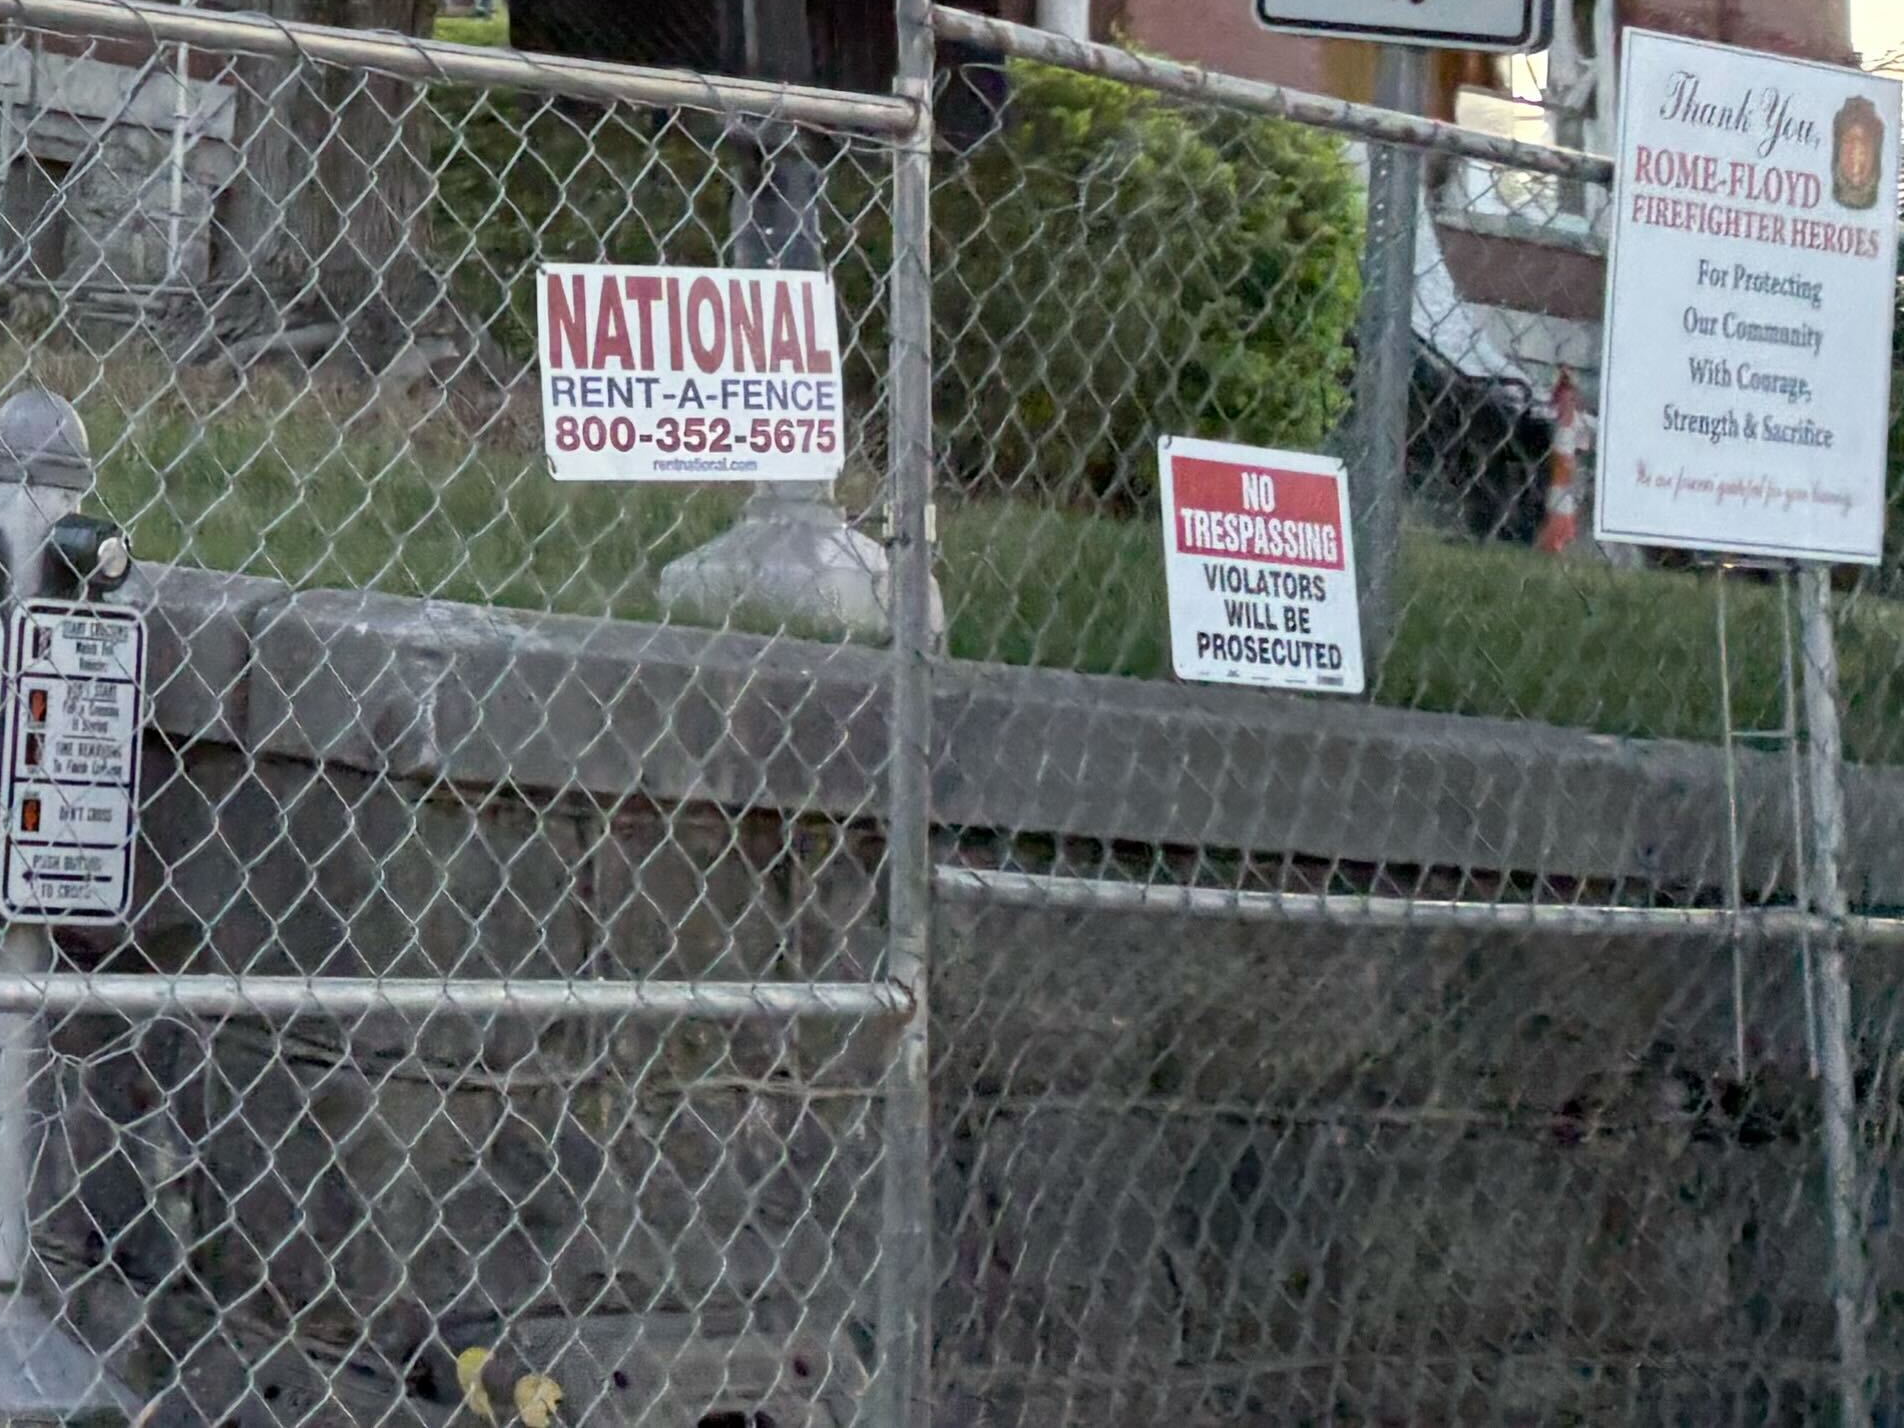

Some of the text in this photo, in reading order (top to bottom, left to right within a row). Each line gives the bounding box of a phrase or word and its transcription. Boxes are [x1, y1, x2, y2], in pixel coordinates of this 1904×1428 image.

[1660, 71, 1821, 158] Thank You,
[1635, 145, 1821, 210] ROME-FLOYD
[1631, 194, 1881, 259] FIREFIGHTER HEROES
[1697, 259, 1823, 310] For Protecting
[547, 274, 833, 375] NATIONAL
[1683, 306, 1824, 357] Our Community
[550, 375, 837, 412] RENT-A-FENCE
[1688, 357, 1812, 404] With Courage,
[555, 415, 836, 454] 800-352-5675
[1663, 404, 1834, 448] Strength & Sacrifice
[653, 457, 758, 473] rentnational.com
[1241, 472, 1275, 513] NO
[1181, 507, 1338, 564] TRESPASSING
[1203, 563, 1326, 603] VIOLATORS
[1224, 599, 1312, 634] WILL BE
[1197, 631, 1342, 670] PROSECUTED
